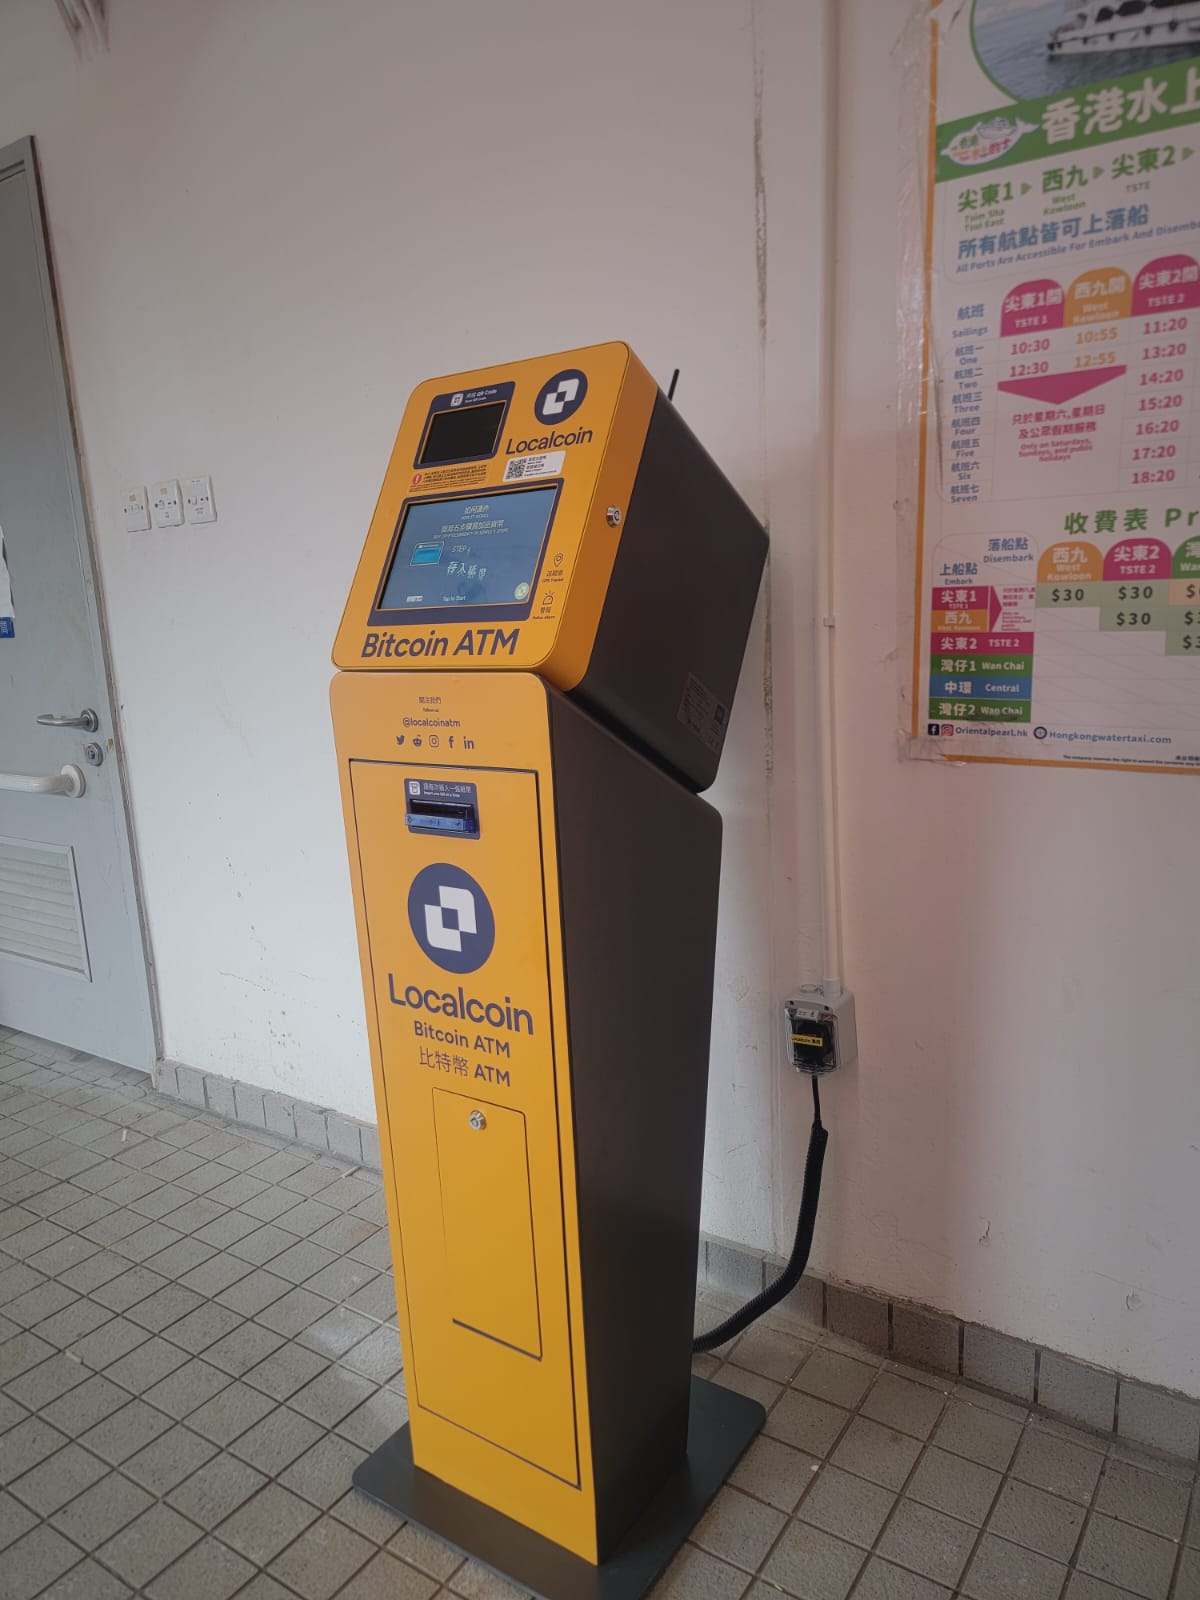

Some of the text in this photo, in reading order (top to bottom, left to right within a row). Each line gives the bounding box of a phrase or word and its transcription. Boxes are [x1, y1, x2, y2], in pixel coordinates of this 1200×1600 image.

[1042, 66, 1200, 144] 香港水上
[958, 145, 1176, 213] 尖東1 西九 尖東2
[958, 204, 1150, 259] 所有航點皆可上落船
[970, 257, 996, 270] Ports
[997, 254, 1013, 265] Are
[1015, 244, 1067, 262] Accessible
[1069, 241, 1087, 252] For
[1088, 234, 1129, 249] Embark
[1132, 228, 1153, 240] And
[952, 325, 989, 340] Sailings
[1144, 317, 1188, 336] 11:20
[1076, 327, 1119, 346] 10:55
[1011, 339, 1051, 356] 10:30
[1142, 343, 1187, 361] 13:20
[959, 356, 978, 366] One
[1075, 351, 1117, 369] 12:55
[1010, 361, 1050, 378] 12:30
[1139, 368, 1185, 387] 14:20
[959, 381, 978, 391] Two
[954, 403, 980, 414] Three
[1138, 394, 1183, 412] 15:20
[955, 426, 977, 437] Four
[1135, 419, 1180, 436] 16:20
[505, 426, 593, 455] Localcoin
[956, 449, 975, 459] Five
[1132, 444, 1177, 461] 17:20
[958, 471, 972, 481] Six
[1131, 468, 1176, 485] 18:20
[951, 493, 978, 504] Seven
[1064, 508, 1148, 535] 收費表
[988, 537, 1029, 552] 落船點
[983, 552, 1034, 564] Disembark
[1052, 547, 1088, 563] 西九
[1113, 544, 1160, 562] 尖東2
[939, 562, 978, 577] 上船點
[1119, 564, 1156, 575] TSTE 2
[944, 577, 973, 586] Embark
[941, 589, 977, 604] 尖東1
[1052, 588, 1085, 602] $30
[1118, 585, 1153, 600] $30
[944, 612, 973, 625] 西九
[1116, 612, 1151, 627] $30
[360, 628, 520, 658] Bitcoin ATM
[941, 637, 1020, 650] 尖東2 TSTE 2
[941, 659, 1025, 672] 灣仔1 Wan Chai
[944, 681, 1020, 694] 中環 Central
[939, 703, 1023, 717] 灣仔2 Wan Chai
[402, 716, 461, 728] @localcoinatm
[1049, 730, 1172, 745] Hongkongwatertaxi.com
[388, 973, 534, 1035] Localcoin
[414, 1020, 510, 1058] Bitcoin ATM
[419, 1046, 510, 1087] 比特幣 ATM
